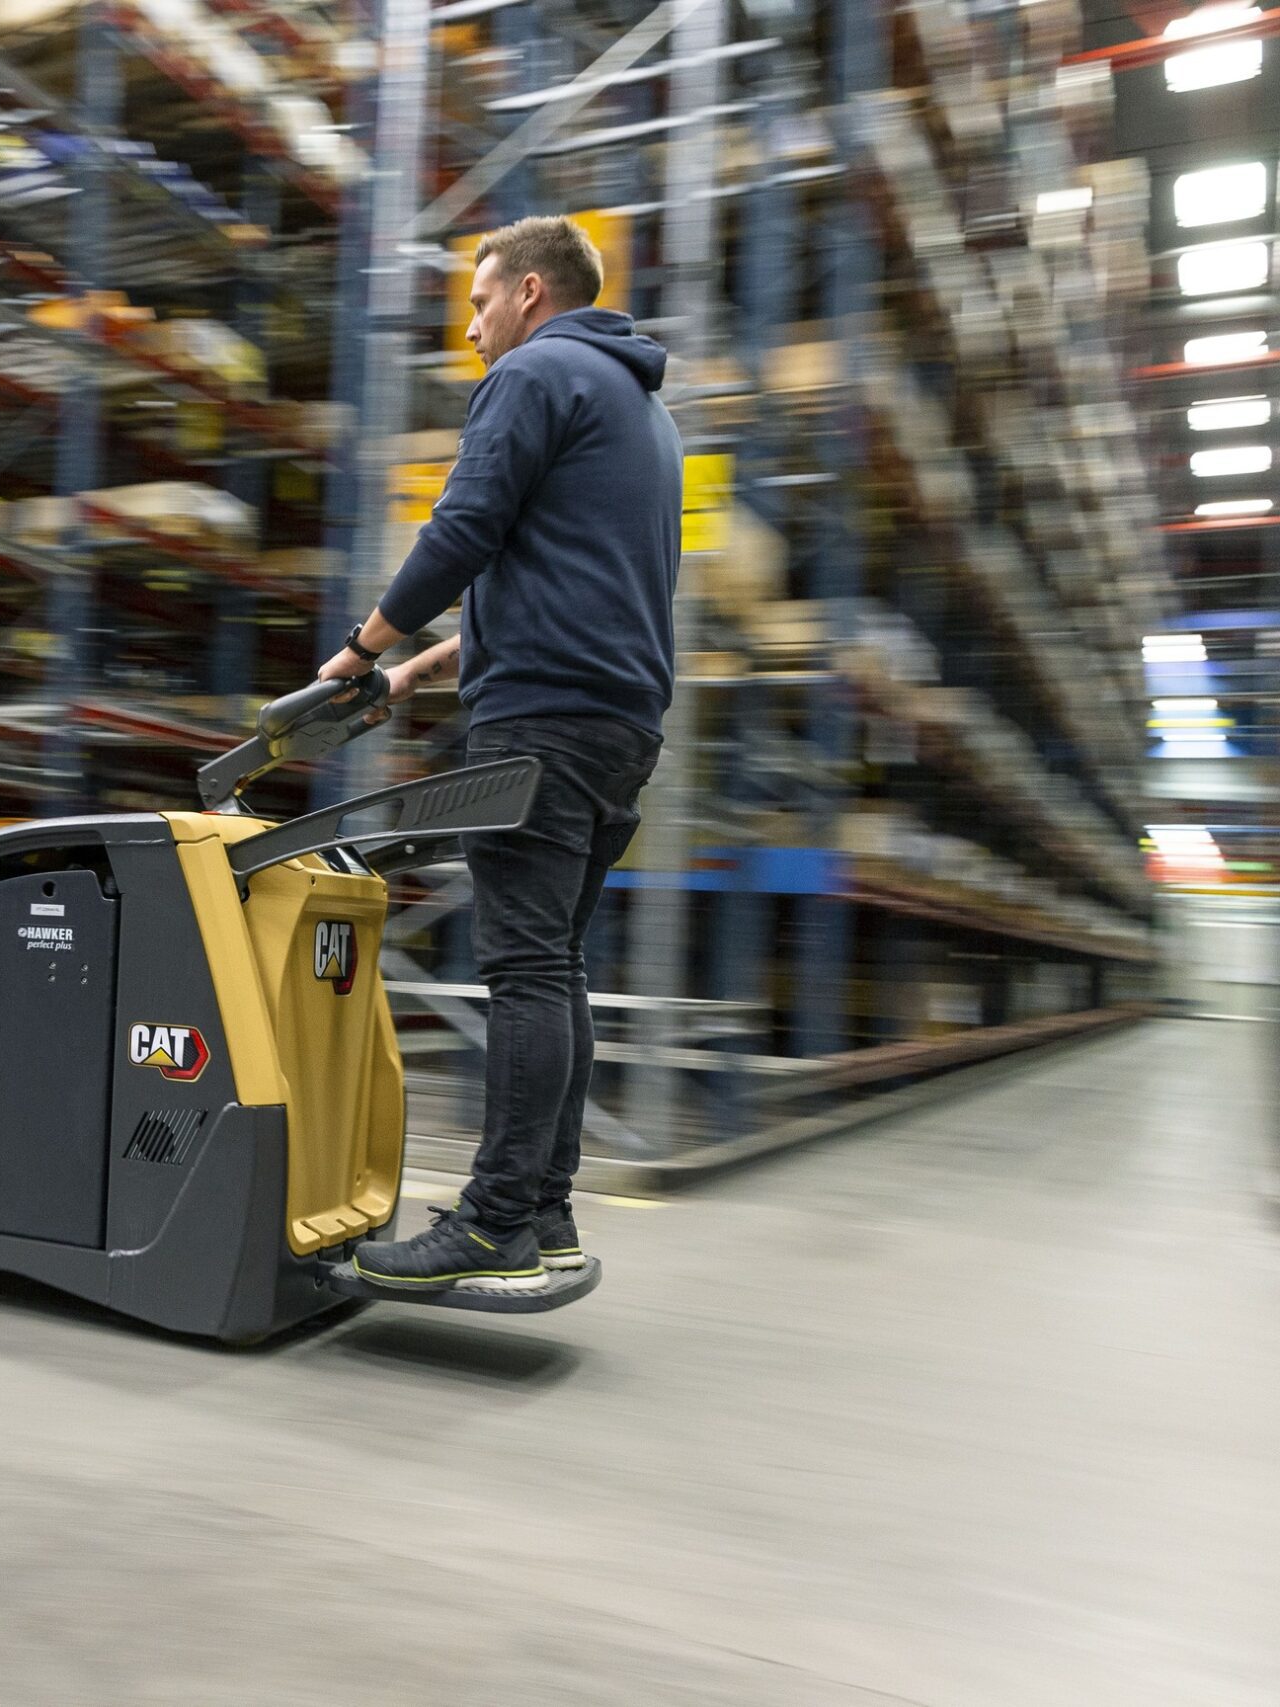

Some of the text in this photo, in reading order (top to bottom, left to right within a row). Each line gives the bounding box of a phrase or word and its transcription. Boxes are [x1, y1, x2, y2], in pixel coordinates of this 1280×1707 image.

[26, 940, 72, 951] perfect plus
[27, 927, 73, 940] HAWKER
[315, 922, 350, 977] CAT
[131, 1024, 190, 1067] CAT
